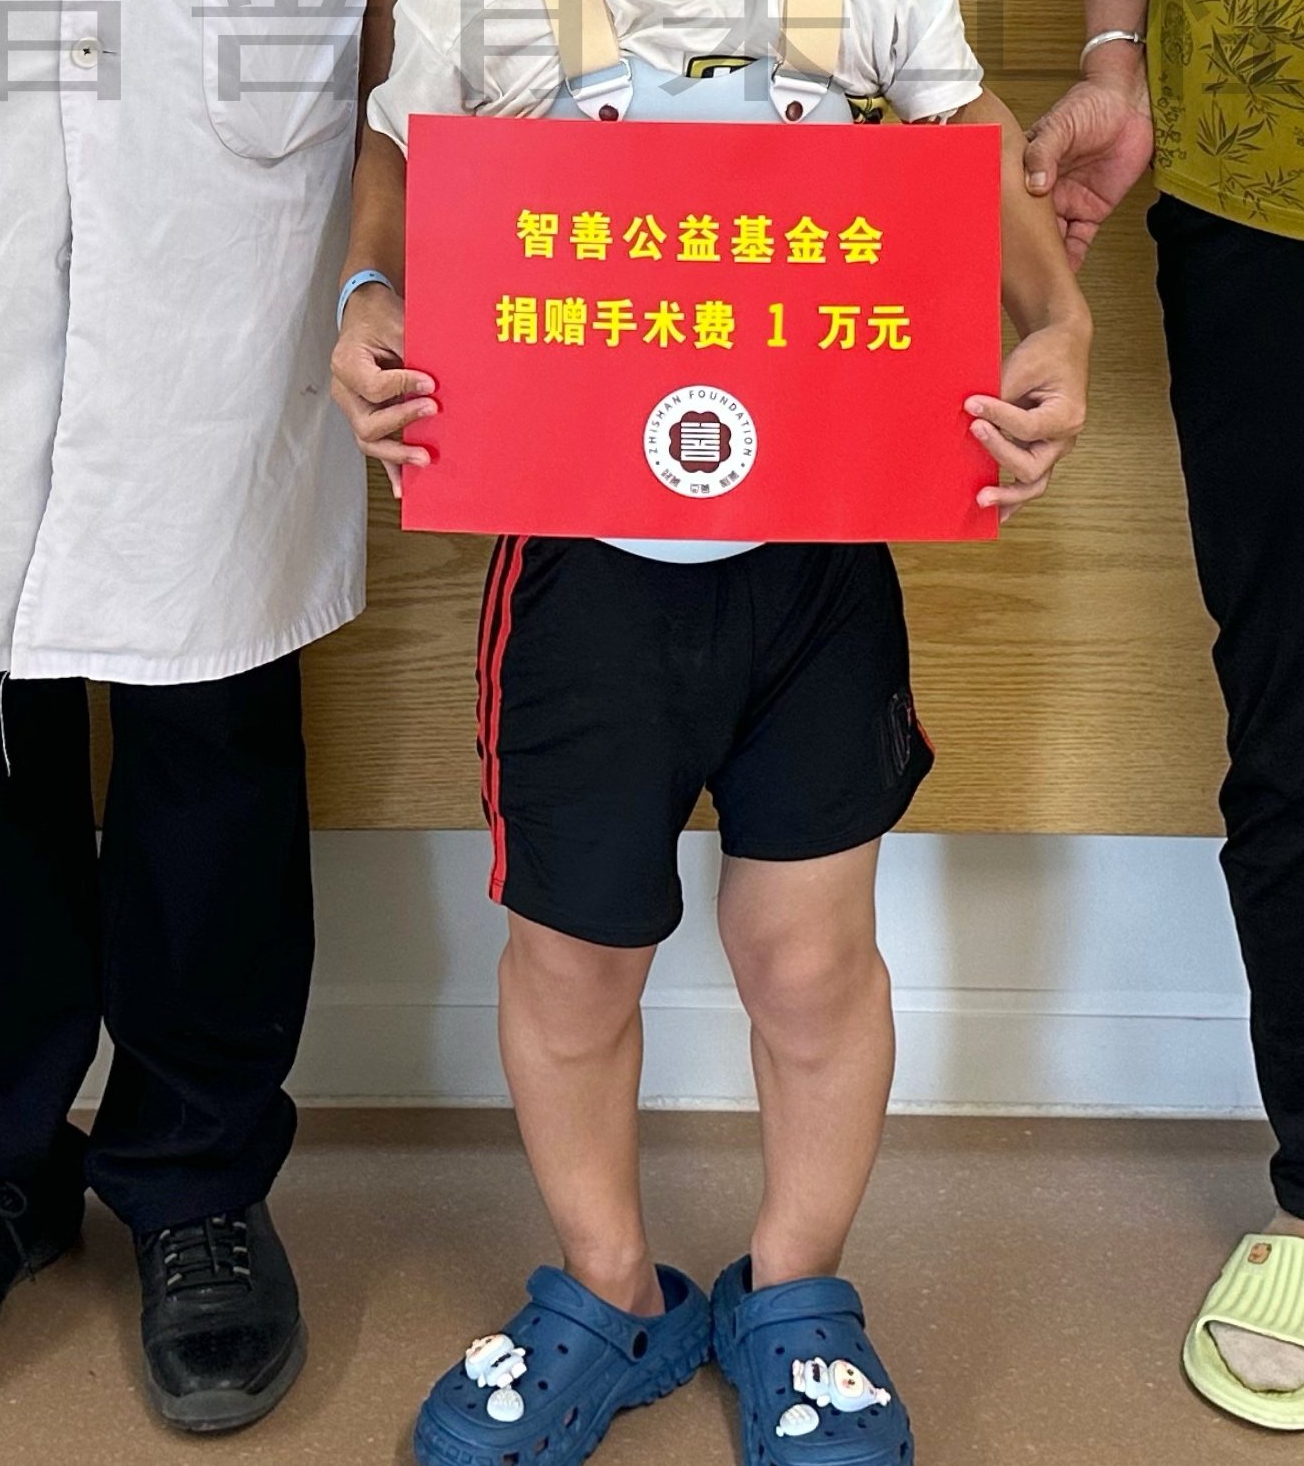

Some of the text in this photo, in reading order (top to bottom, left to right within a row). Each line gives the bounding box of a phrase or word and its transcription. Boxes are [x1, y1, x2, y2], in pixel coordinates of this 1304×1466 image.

[516, 209, 883, 265] 智善公益基金会
[495, 294, 912, 351] 捐赠手术费 1 万元
[648, 389, 753, 457] ZHISHAN FOUNDATION
